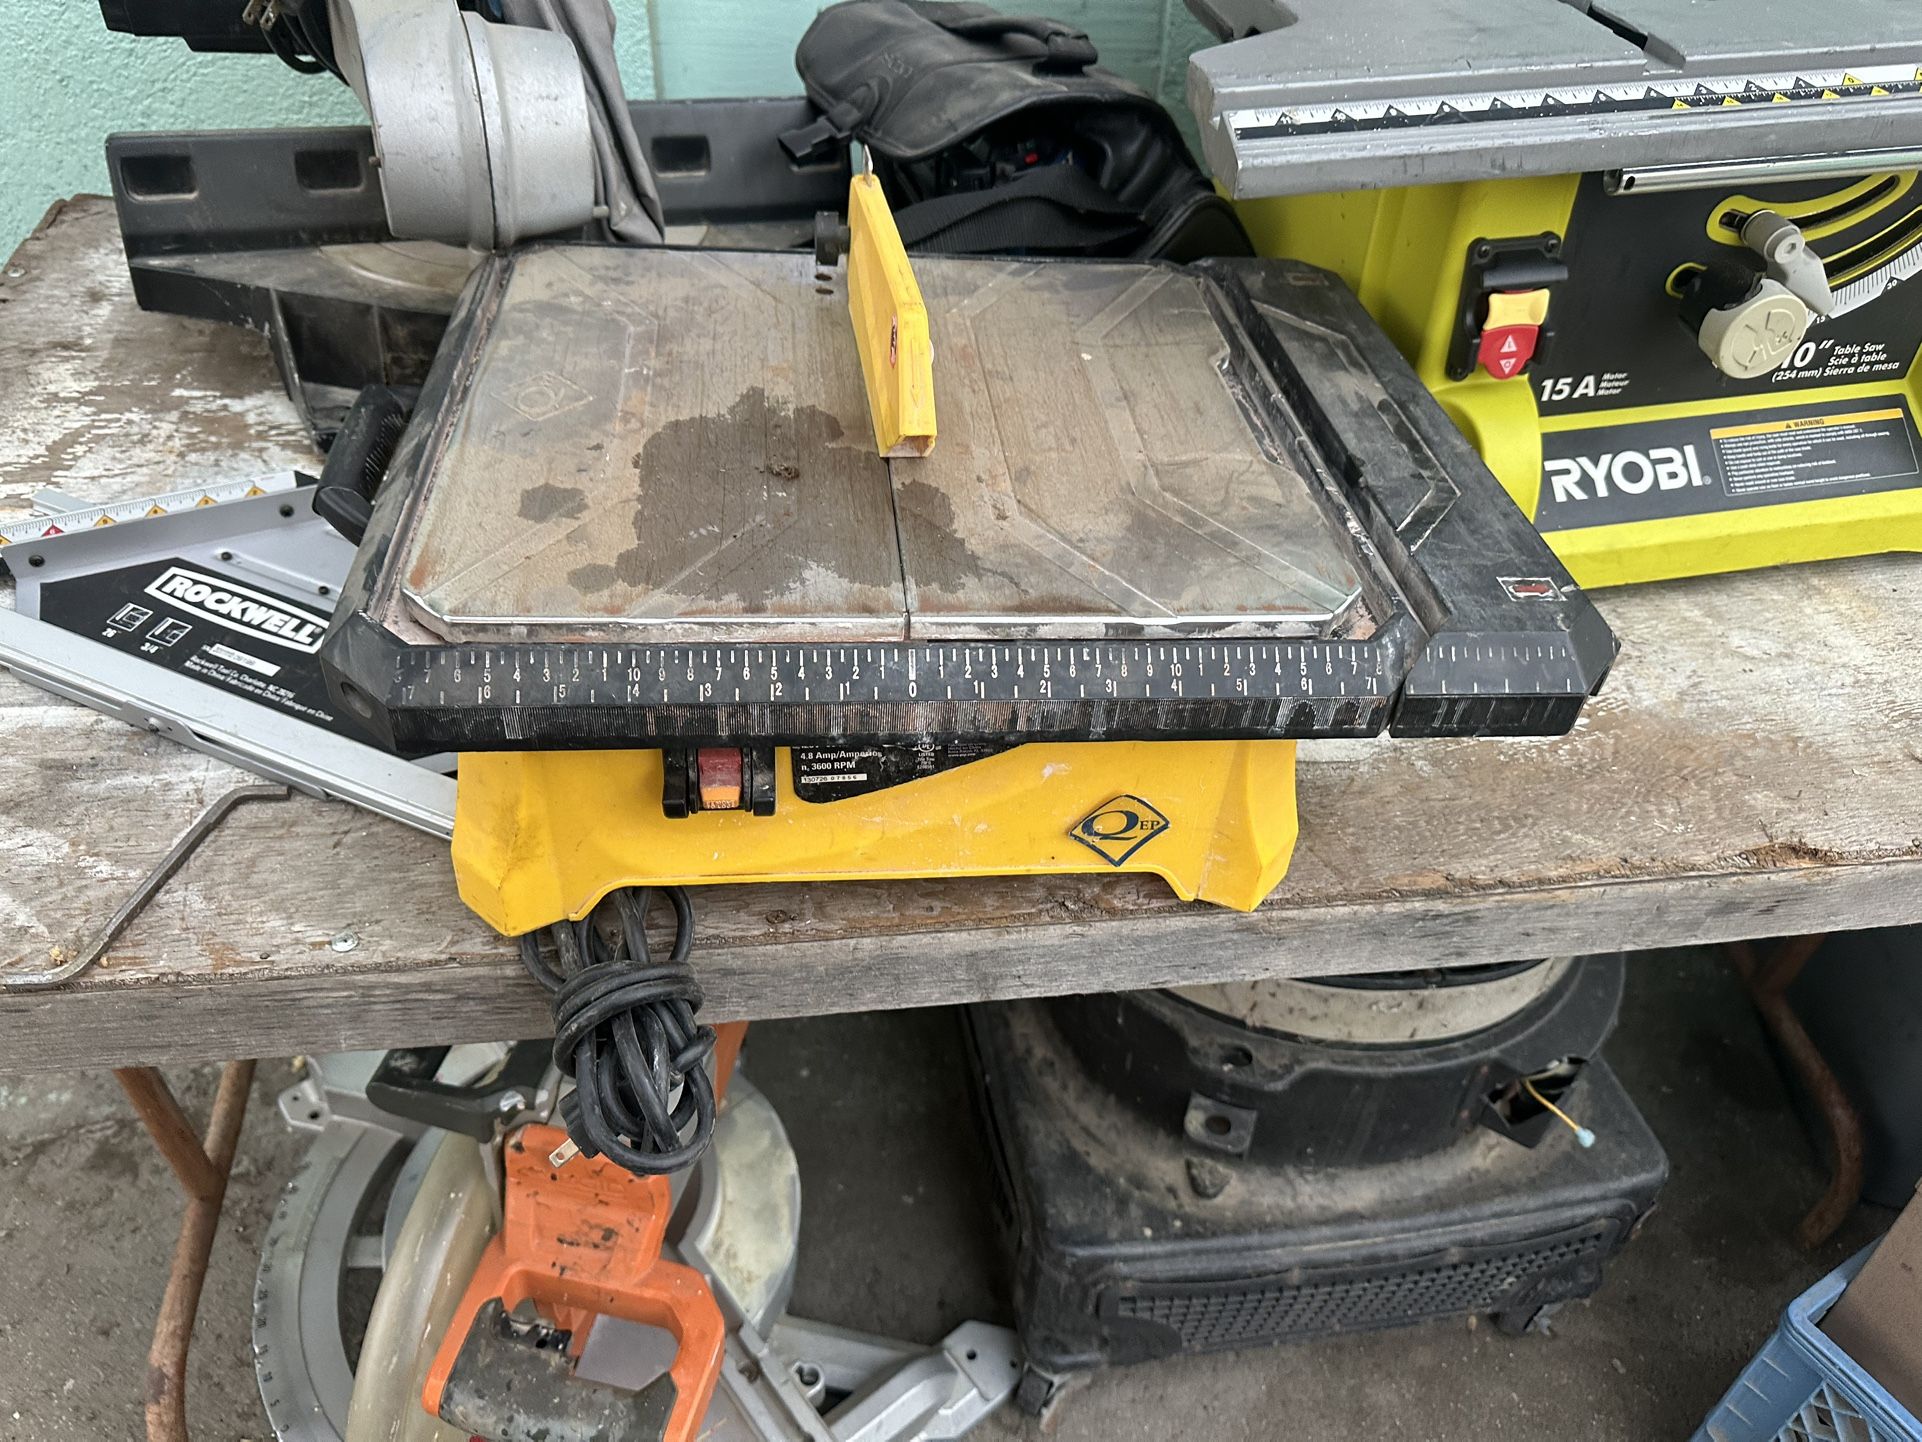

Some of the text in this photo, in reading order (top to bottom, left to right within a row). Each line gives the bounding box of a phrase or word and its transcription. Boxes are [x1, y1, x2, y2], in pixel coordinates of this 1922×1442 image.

[1886, 279, 1898, 290] 30
[1834, 342, 1885, 356] Table Saw
[1828, 352, 1887, 367] Scie à table
[1602, 372, 1628, 380] Motor
[1771, 362, 1900, 383] (254 mm) Sierra de mesa
[1541, 375, 1595, 401] 15 A
[1793, 418, 1825, 428] WARNING
[1544, 444, 1703, 503] RYOBI
[162, 576, 315, 644] ROCKWELL
[190, 655, 219, 670] Rockwell
[424, 669, 431, 683] 7
[454, 669, 462, 683] 6
[483, 669, 491, 683] 5
[513, 669, 521, 683] 4
[543, 669, 551, 683] 3
[572, 669, 580, 683] 2
[602, 669, 607, 683] 1
[627, 667, 641, 681] 10
[658, 667, 666, 681] 9
[687, 667, 695, 681] 8
[716, 667, 723, 681] 7
[743, 667, 750, 681] 6
[770, 666, 778, 679] 5
[797, 666, 805, 679] 4
[825, 666, 833, 679] 3
[852, 666, 859, 679] 2
[880, 666, 885, 679] 1
[939, 665, 944, 678] 1
[964, 665, 972, 678] 2
[991, 665, 998, 678] 3
[1017, 664, 1024, 678] 4
[1043, 664, 1051, 678] 5
[1069, 664, 1076, 678] 6
[1096, 664, 1102, 678] 7
[1121, 664, 1128, 678] 8
[1146, 664, 1154, 678] 9
[1170, 663, 1182, 676] 10
[1198, 663, 1203, 676] 1
[1223, 663, 1230, 676] 2
[1249, 663, 1256, 676] 3
[1274, 663, 1282, 676] 4
[1300, 663, 1307, 676] 5
[1325, 663, 1333, 676] 6
[1351, 663, 1358, 676] 7
[408, 677, 1372, 700] 7 6 5 4 3 2 1 0 1 2 3 4 5 6 7
[800, 752, 814, 760] 4.8
[811, 763, 832, 771] 3600
[834, 761, 856, 770] RPM
[1081, 810, 1160, 841] QEP
